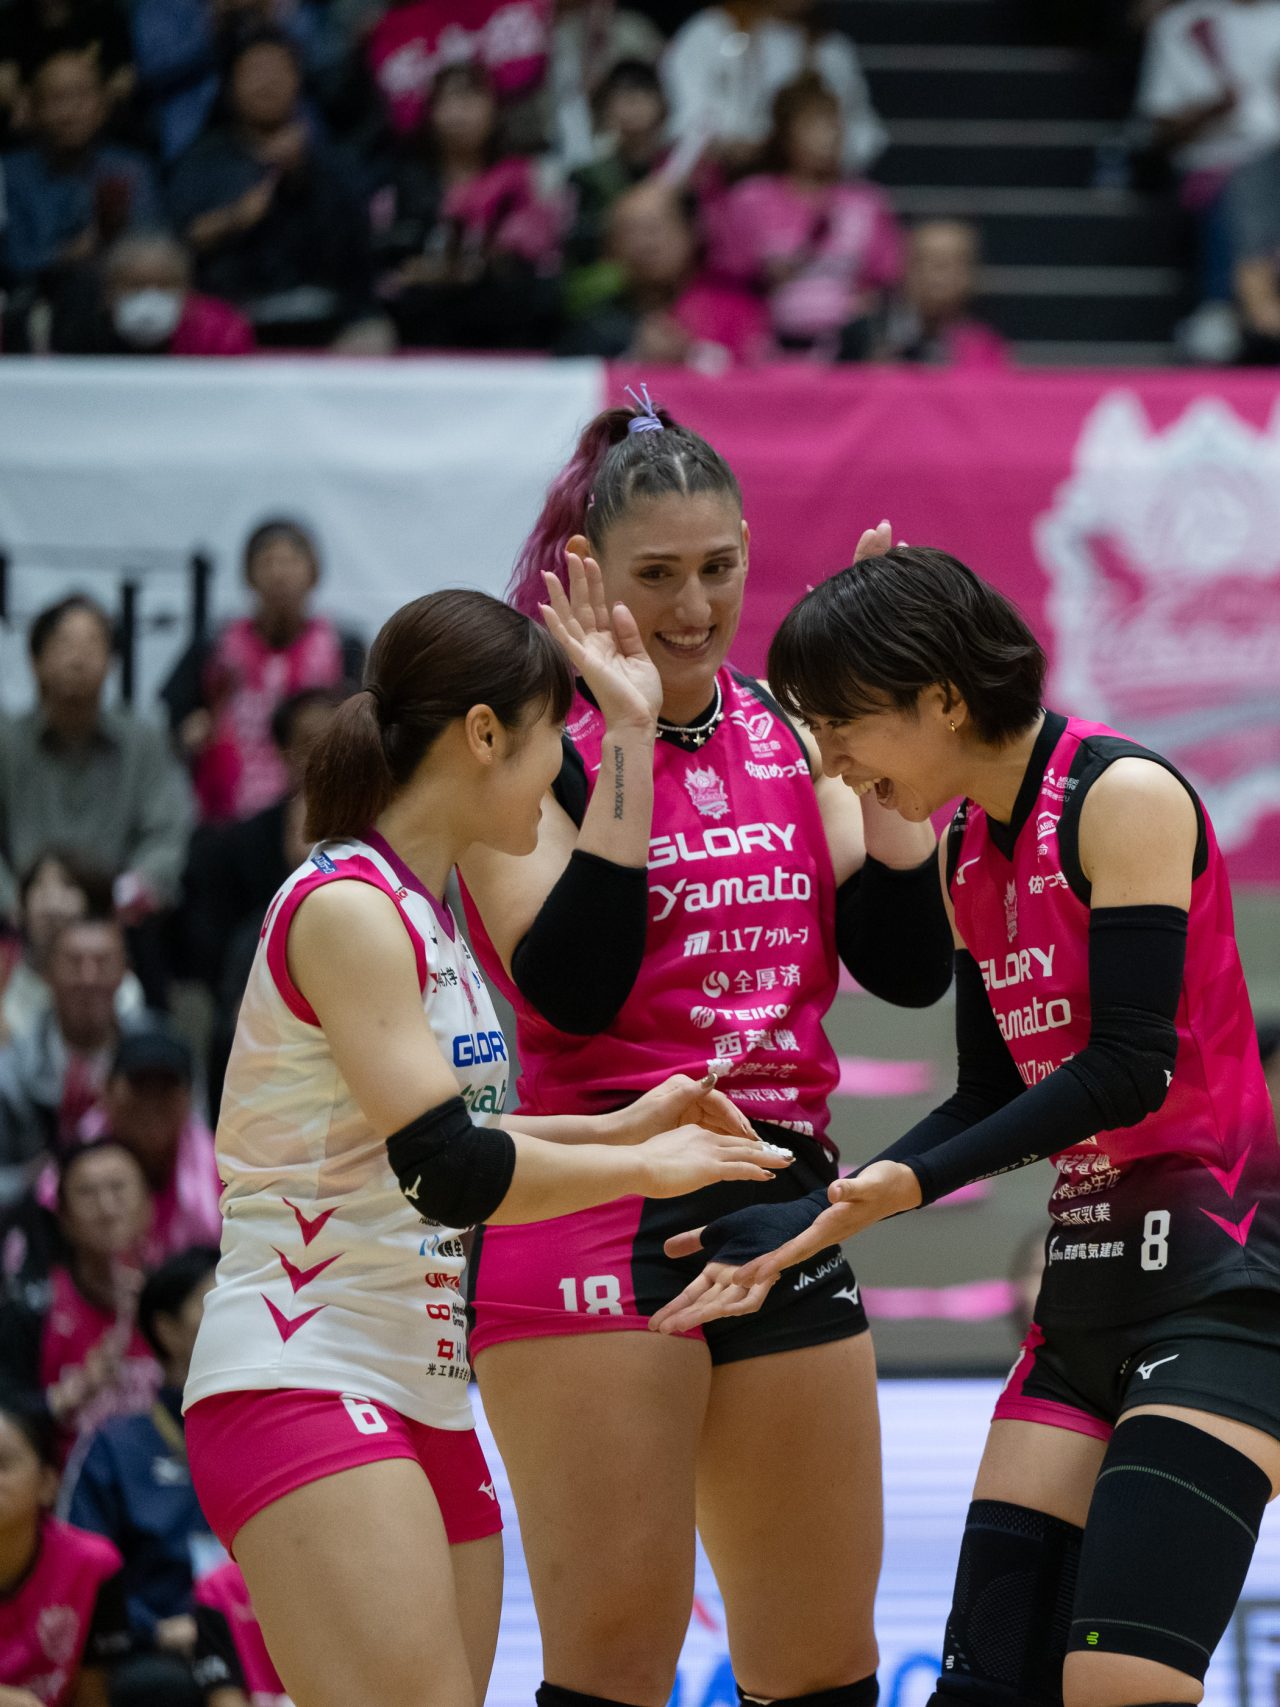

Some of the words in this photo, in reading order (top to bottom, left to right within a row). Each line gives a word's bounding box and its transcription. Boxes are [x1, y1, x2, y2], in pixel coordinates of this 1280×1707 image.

[647, 822, 796, 870] GLORY
[648, 866, 811, 922] Yamato
[733, 963, 801, 994] 全厚済
[992, 996, 1072, 1041] amato
[1140, 1209, 1171, 1271] 8
[558, 1274, 624, 1316] 18
[340, 1392, 389, 1435] 6
